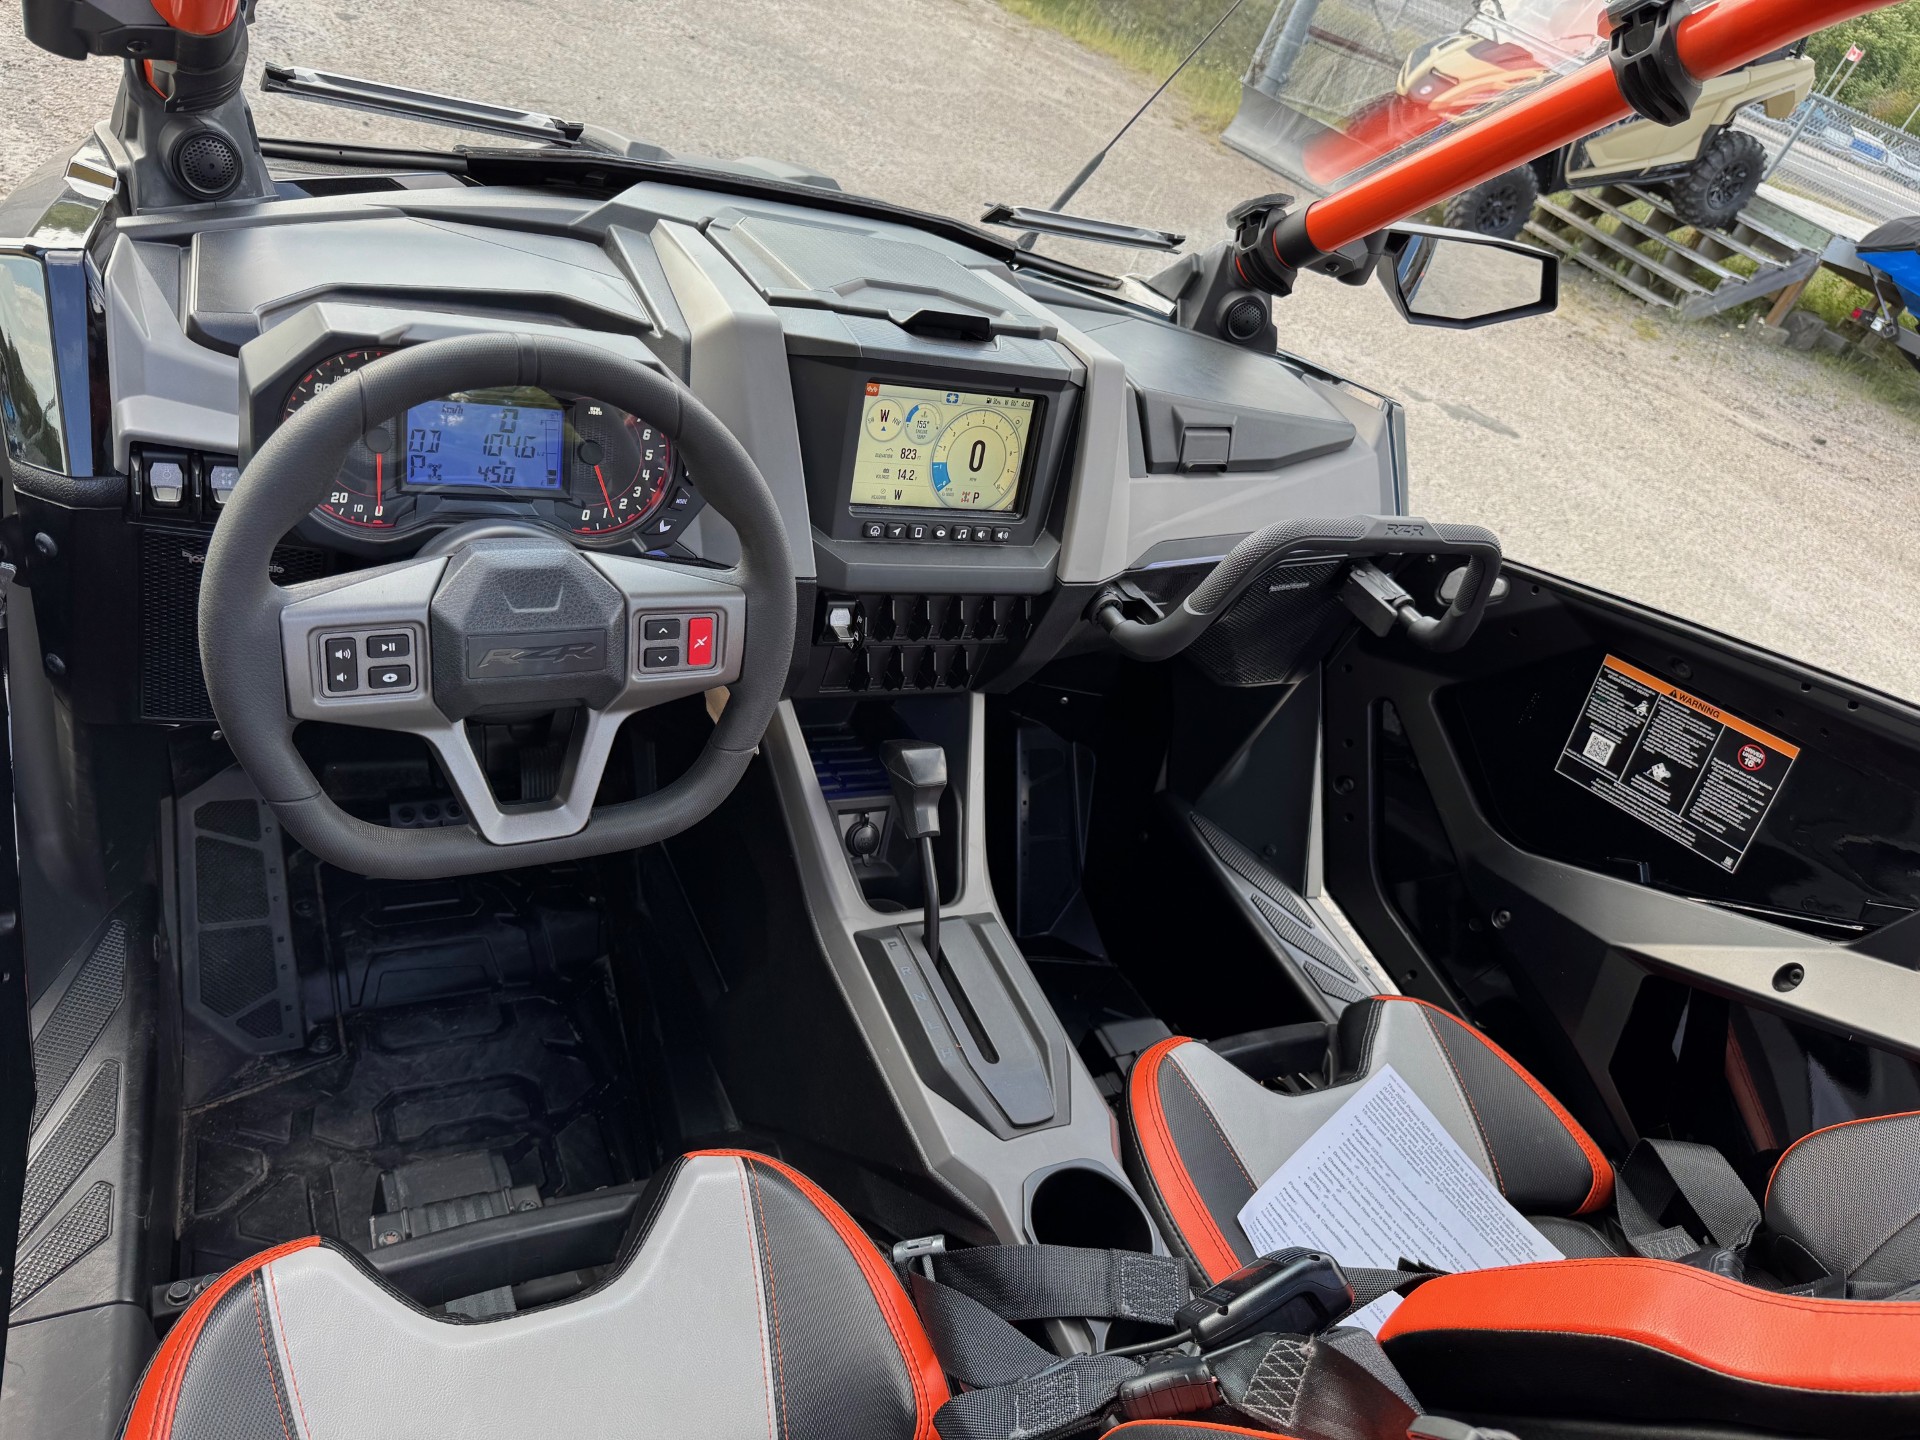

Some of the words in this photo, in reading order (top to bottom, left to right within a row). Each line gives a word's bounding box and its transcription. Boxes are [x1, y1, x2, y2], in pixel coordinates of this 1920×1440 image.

[441, 404, 464, 415] km/h
[500, 408, 519, 434] 0
[880, 409, 890, 423] W
[642, 428, 652, 440] 6
[483, 433, 537, 459] 104.6
[644, 449, 654, 461] 5
[900, 447, 917, 460] 823
[968, 439, 986, 473] 0
[410, 454, 426, 478] P
[477, 465, 516, 484] 4:50
[642, 469, 650, 481] 4
[897, 468, 915, 481] 14.2
[331, 492, 349, 504] 20
[632, 486, 642, 498] 3
[894, 489, 903, 501] W
[972, 492, 980, 504] P
[353, 504, 364, 513] 10
[618, 498, 628, 509] 2
[374, 506, 384, 517] 0
[581, 509, 591, 521] 0
[602, 507, 608, 519] 1
[1384, 523, 1425, 537] RZR
[477, 641, 597, 668] RZR
[1679, 693, 1720, 719] WARNING
[1742, 750, 1762, 765] UNDER
[1743, 746, 1765, 761] DRIVER
[1744, 758, 1755, 768] 16
